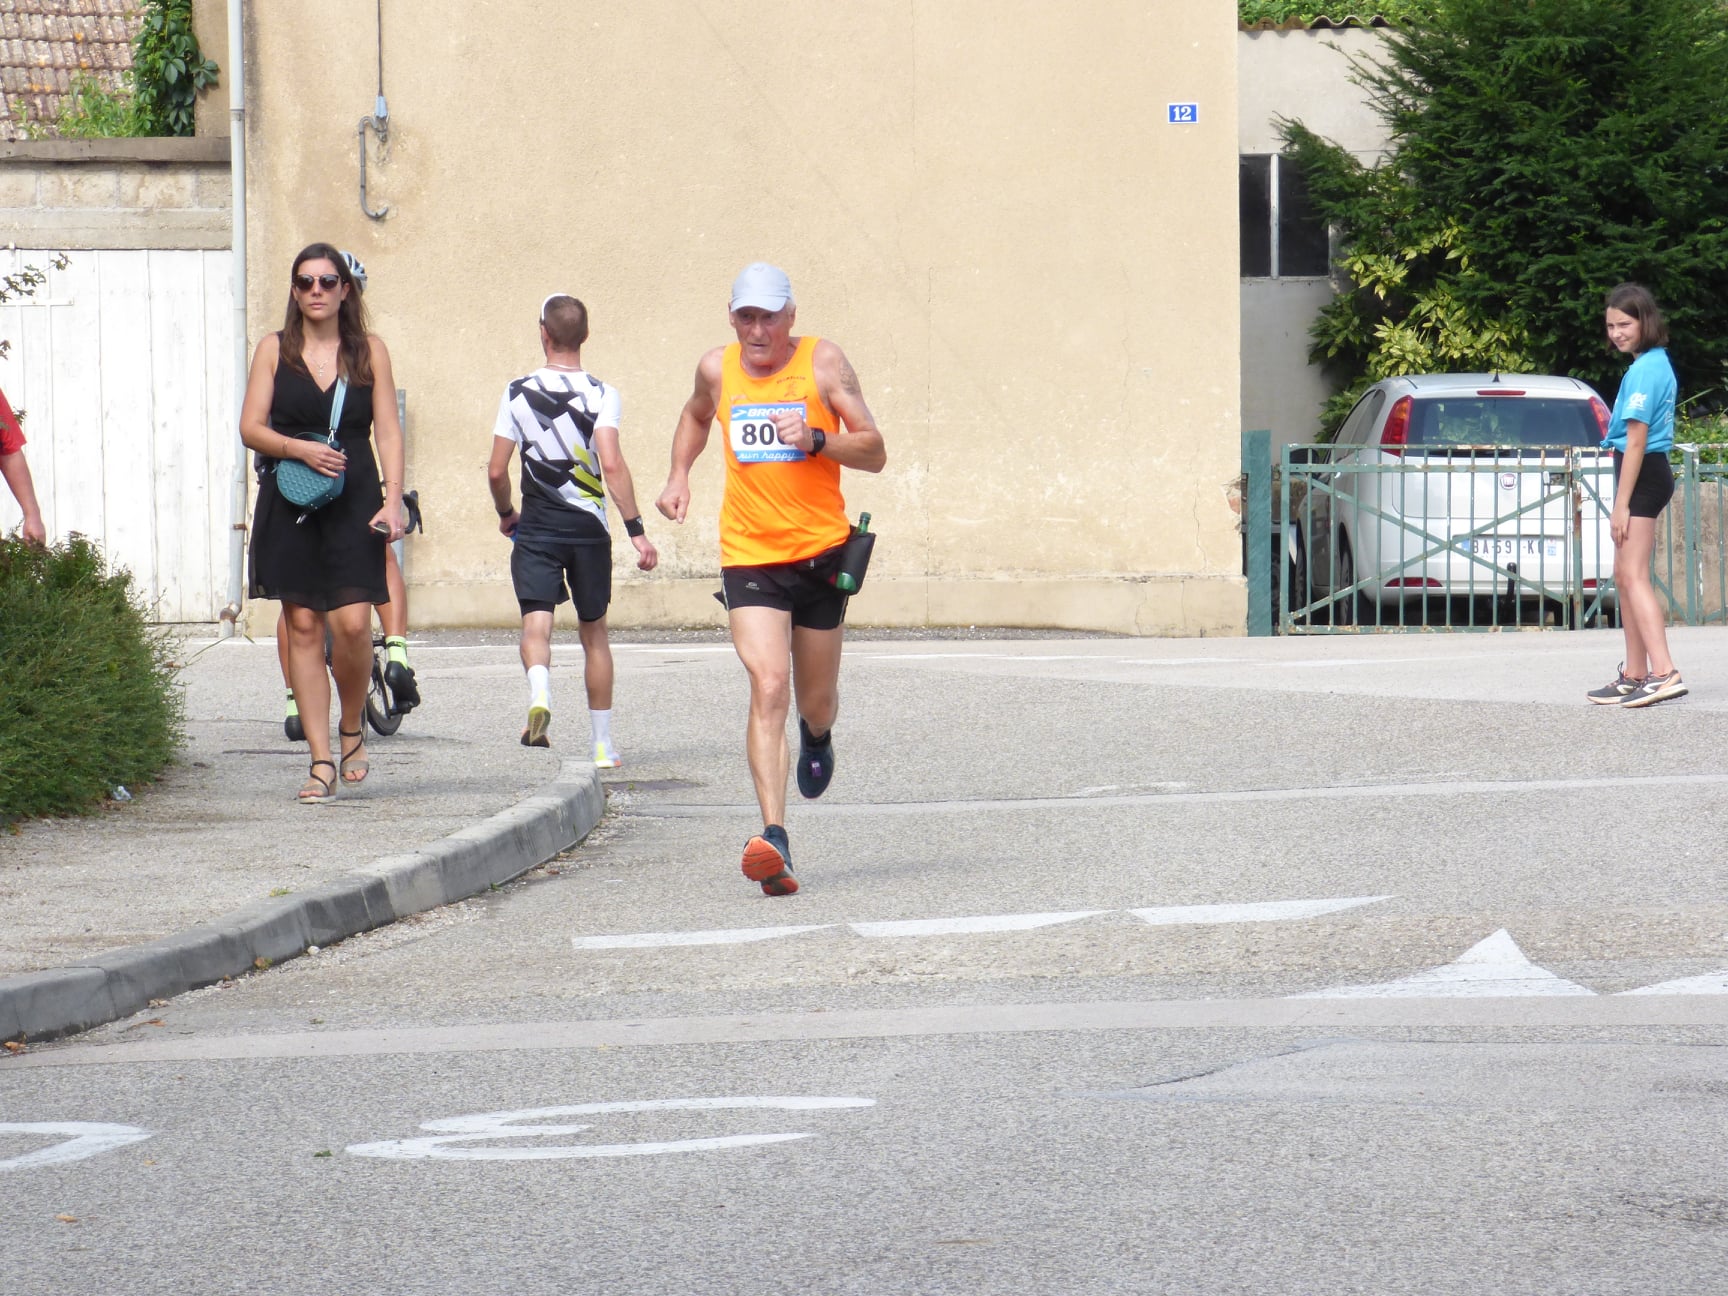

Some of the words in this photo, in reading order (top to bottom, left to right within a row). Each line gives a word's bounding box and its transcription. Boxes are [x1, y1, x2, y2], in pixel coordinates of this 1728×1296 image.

[1173, 106, 1192, 121] 12
[742, 423, 787, 446] 80
[761, 451, 795, 461] happy
